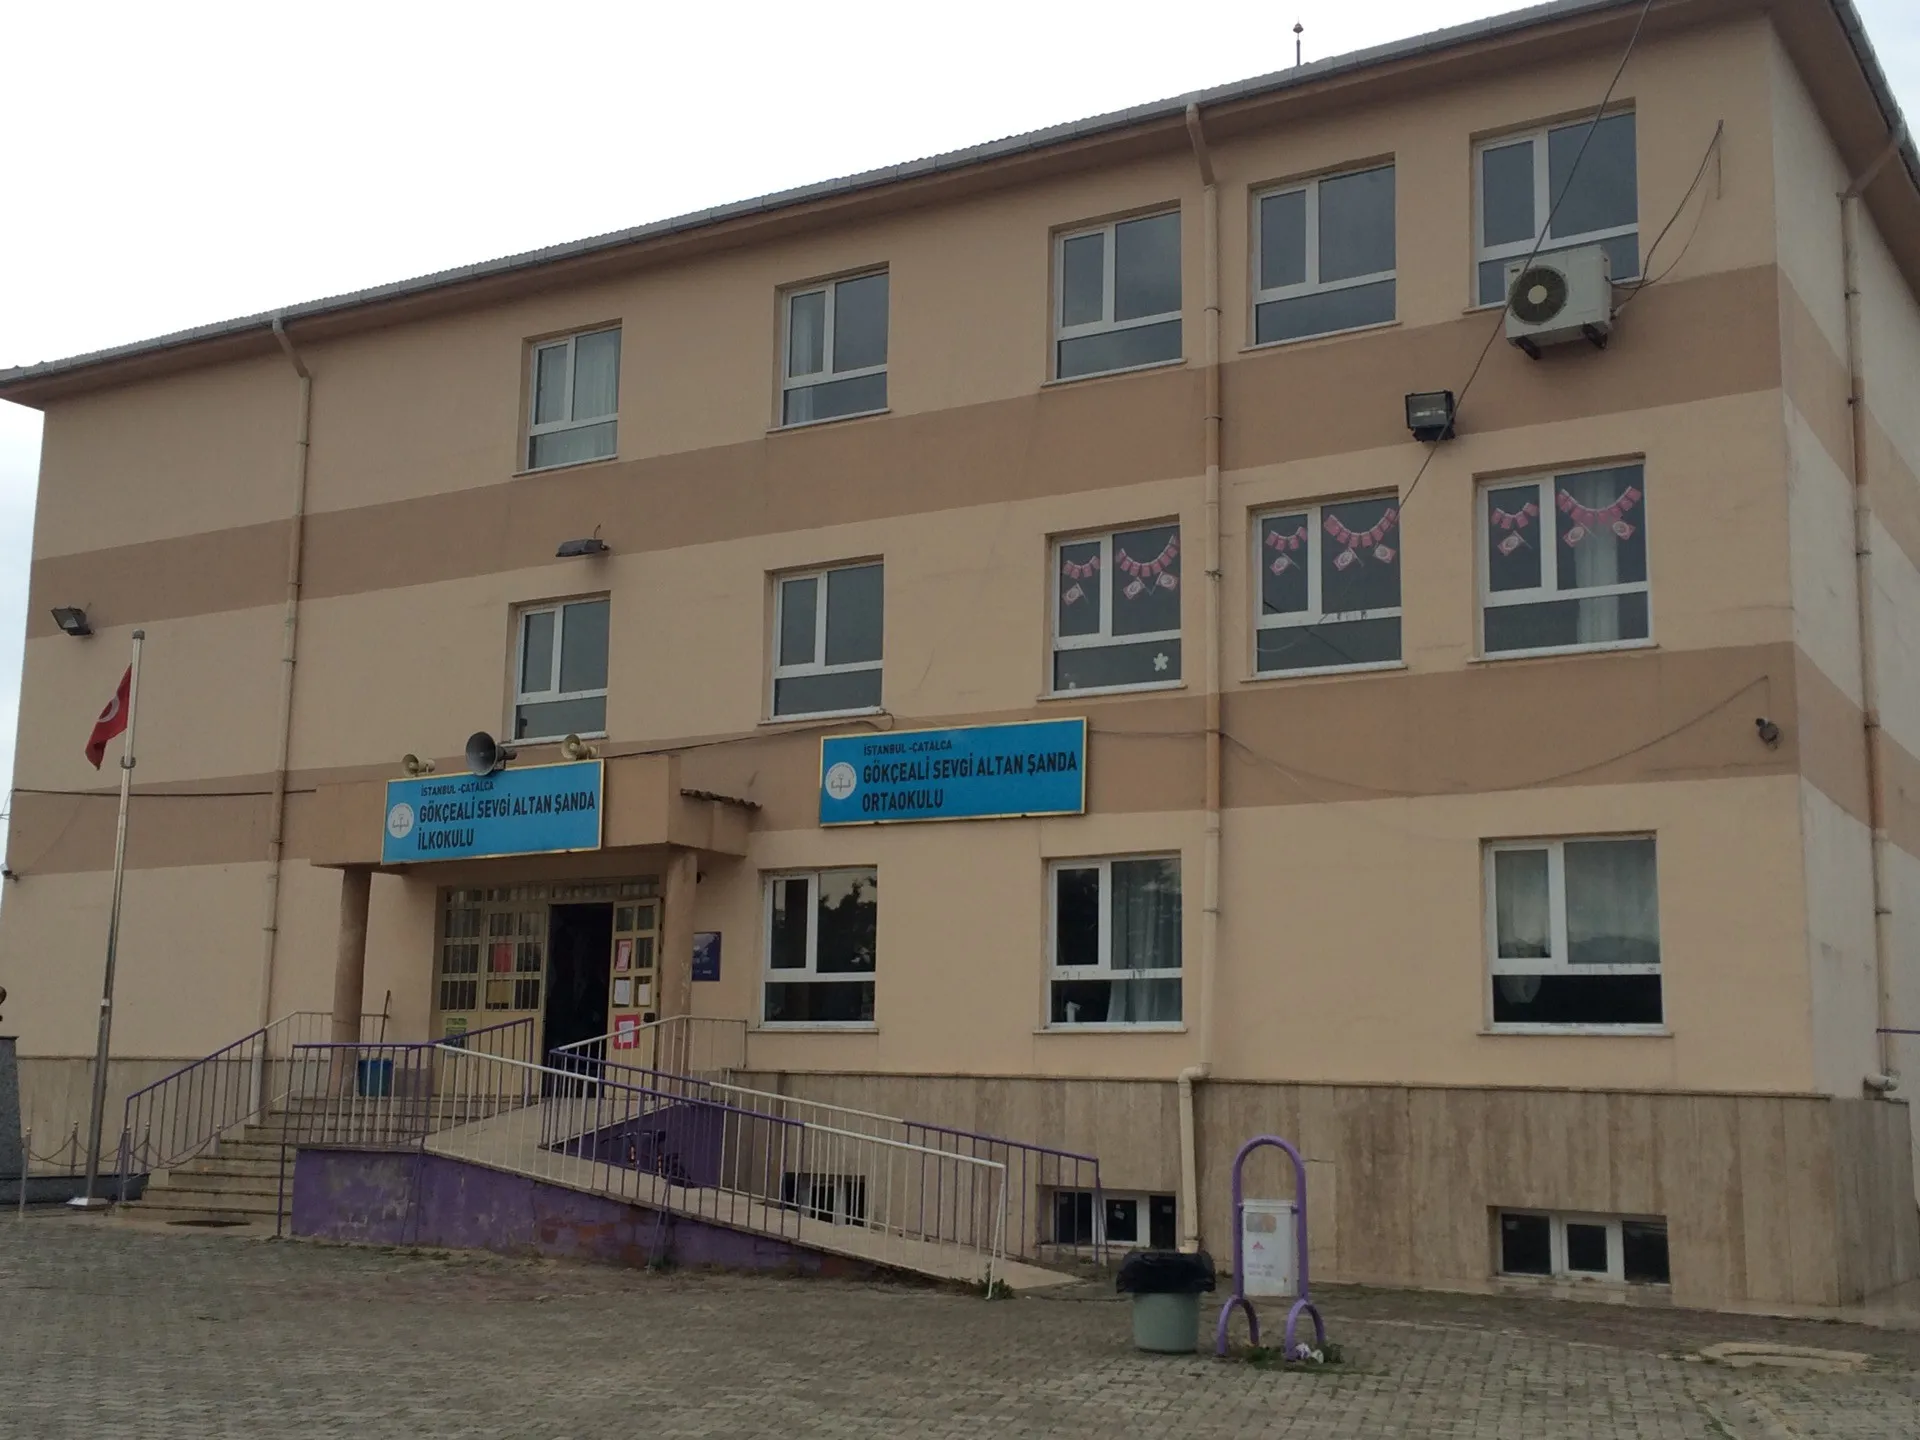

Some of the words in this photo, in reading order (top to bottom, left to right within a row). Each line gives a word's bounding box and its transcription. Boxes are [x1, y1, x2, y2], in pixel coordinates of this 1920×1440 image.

[863, 756, 930, 785] GÖKÇEALİ
[933, 752, 973, 779] SEVGİ
[976, 755, 1023, 777] ALTAN
[1027, 751, 1077, 774] ŞANDA
[419, 796, 475, 825] GÖKÇEALİ
[477, 793, 511, 819] SEVGİ
[513, 794, 552, 816] ALTAN
[554, 791, 595, 814] ŞANDA
[862, 788, 944, 812] ORTAOKULU
[418, 827, 474, 850] İLKOKULU
